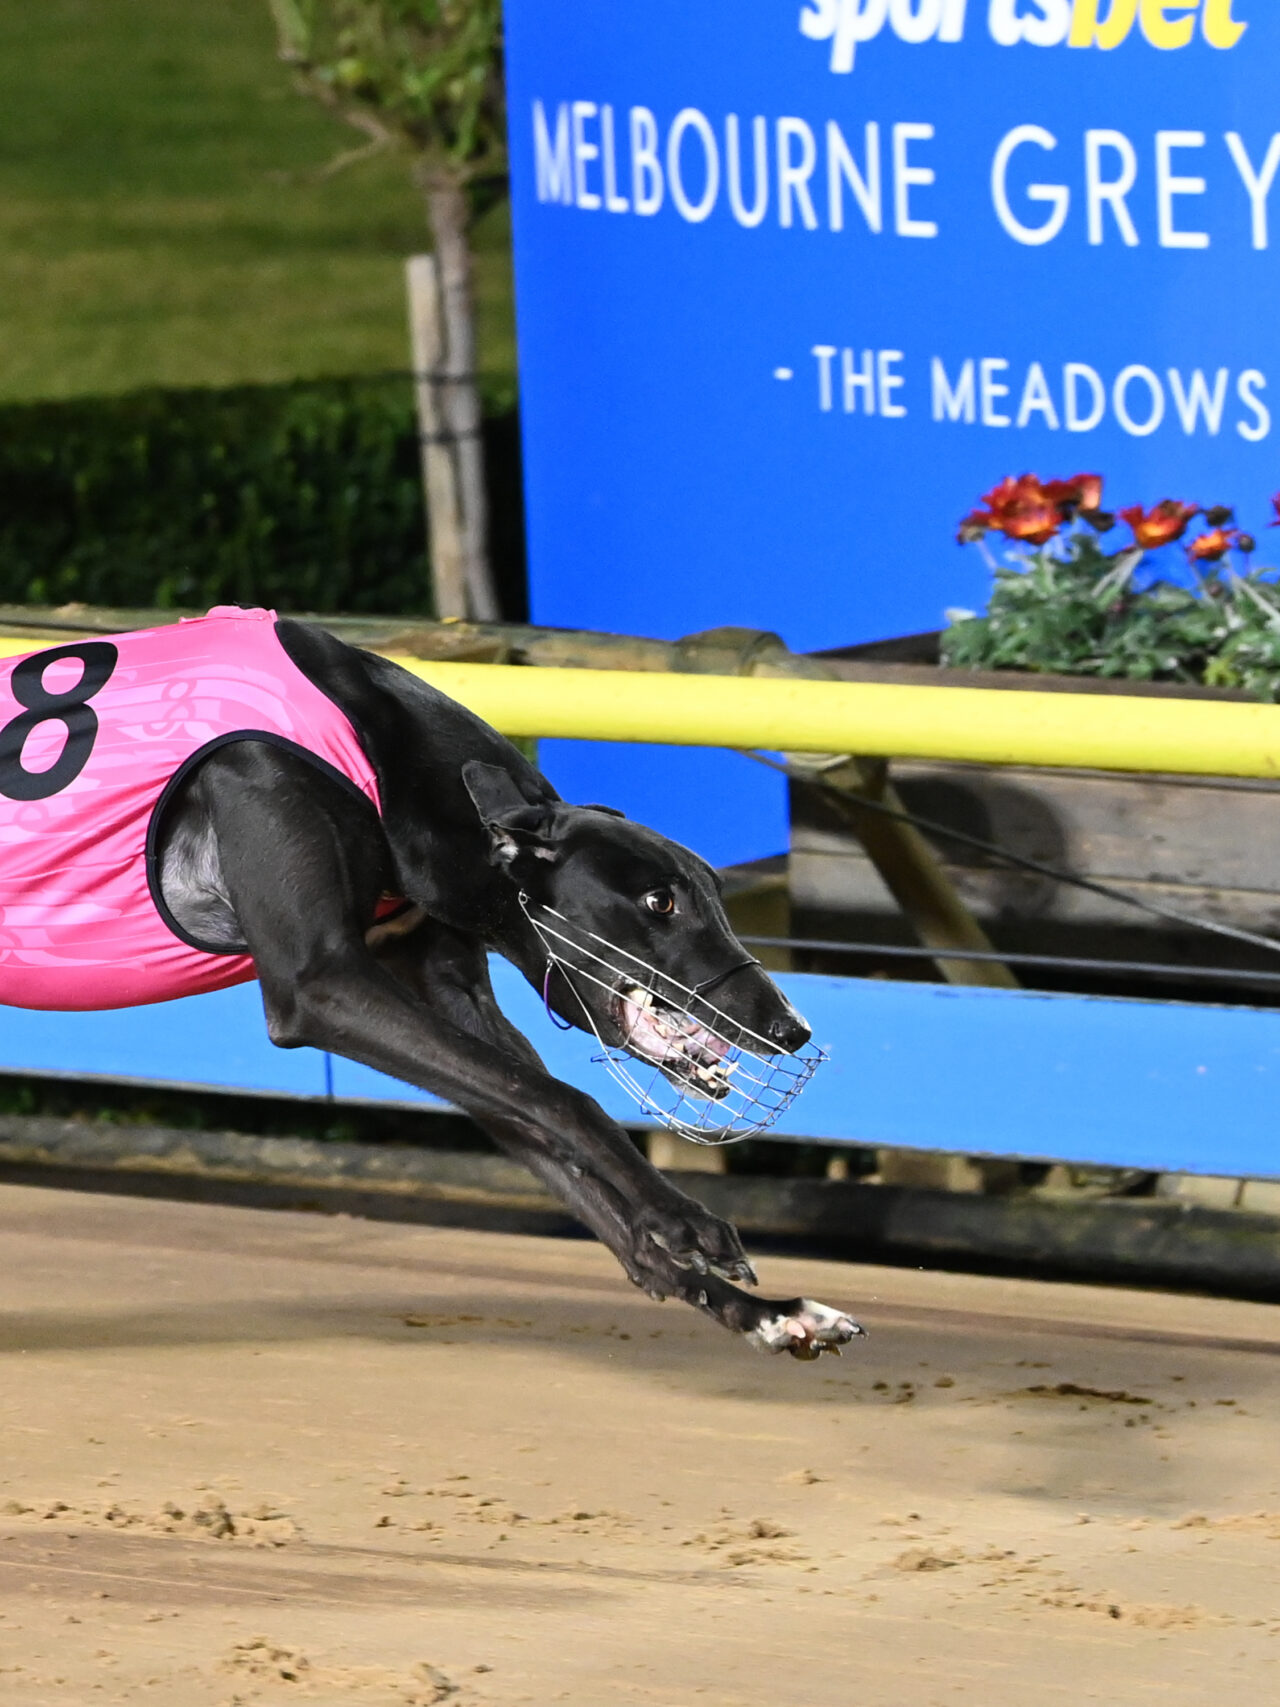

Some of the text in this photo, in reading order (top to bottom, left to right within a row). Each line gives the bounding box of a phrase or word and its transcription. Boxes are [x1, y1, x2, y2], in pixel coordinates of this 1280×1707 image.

[533, 101, 1280, 249] MELBOURNE GREY
[812, 345, 907, 418] THE
[931, 358, 1272, 442] MEADOWS
